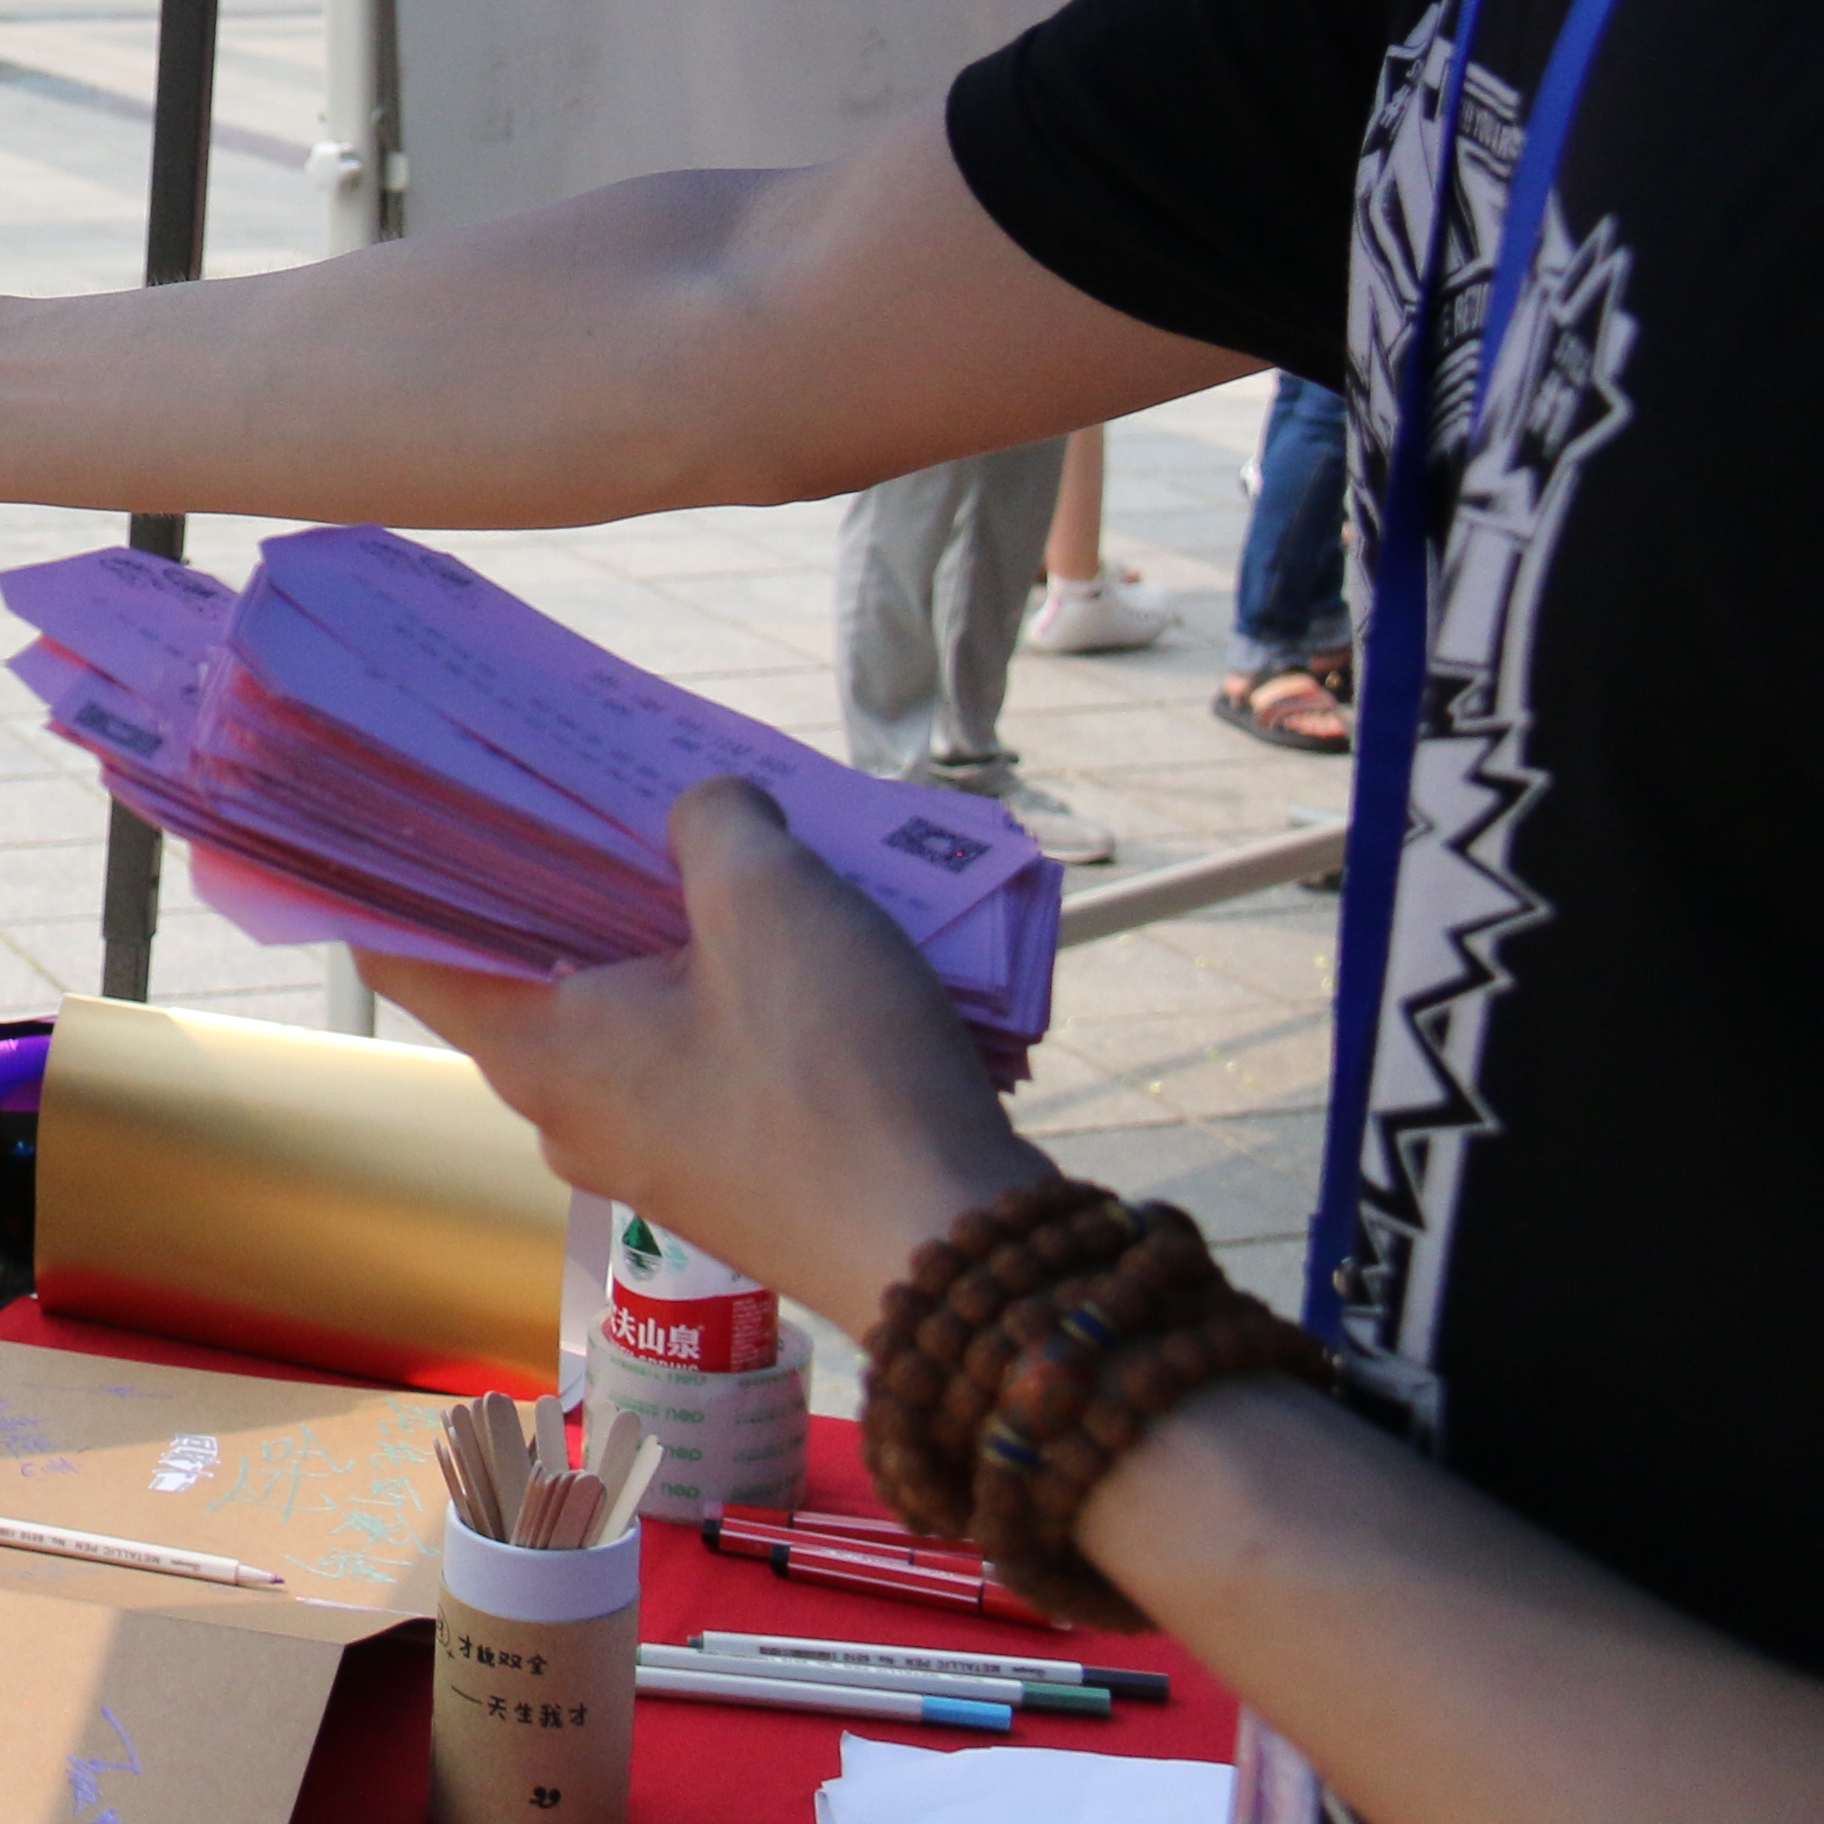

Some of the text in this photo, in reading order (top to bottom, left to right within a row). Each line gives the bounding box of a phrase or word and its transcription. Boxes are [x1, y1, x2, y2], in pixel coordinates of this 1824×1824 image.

[610, 1304, 701, 1359] 夫山泉
[75, 1539, 102, 1555] PEN
